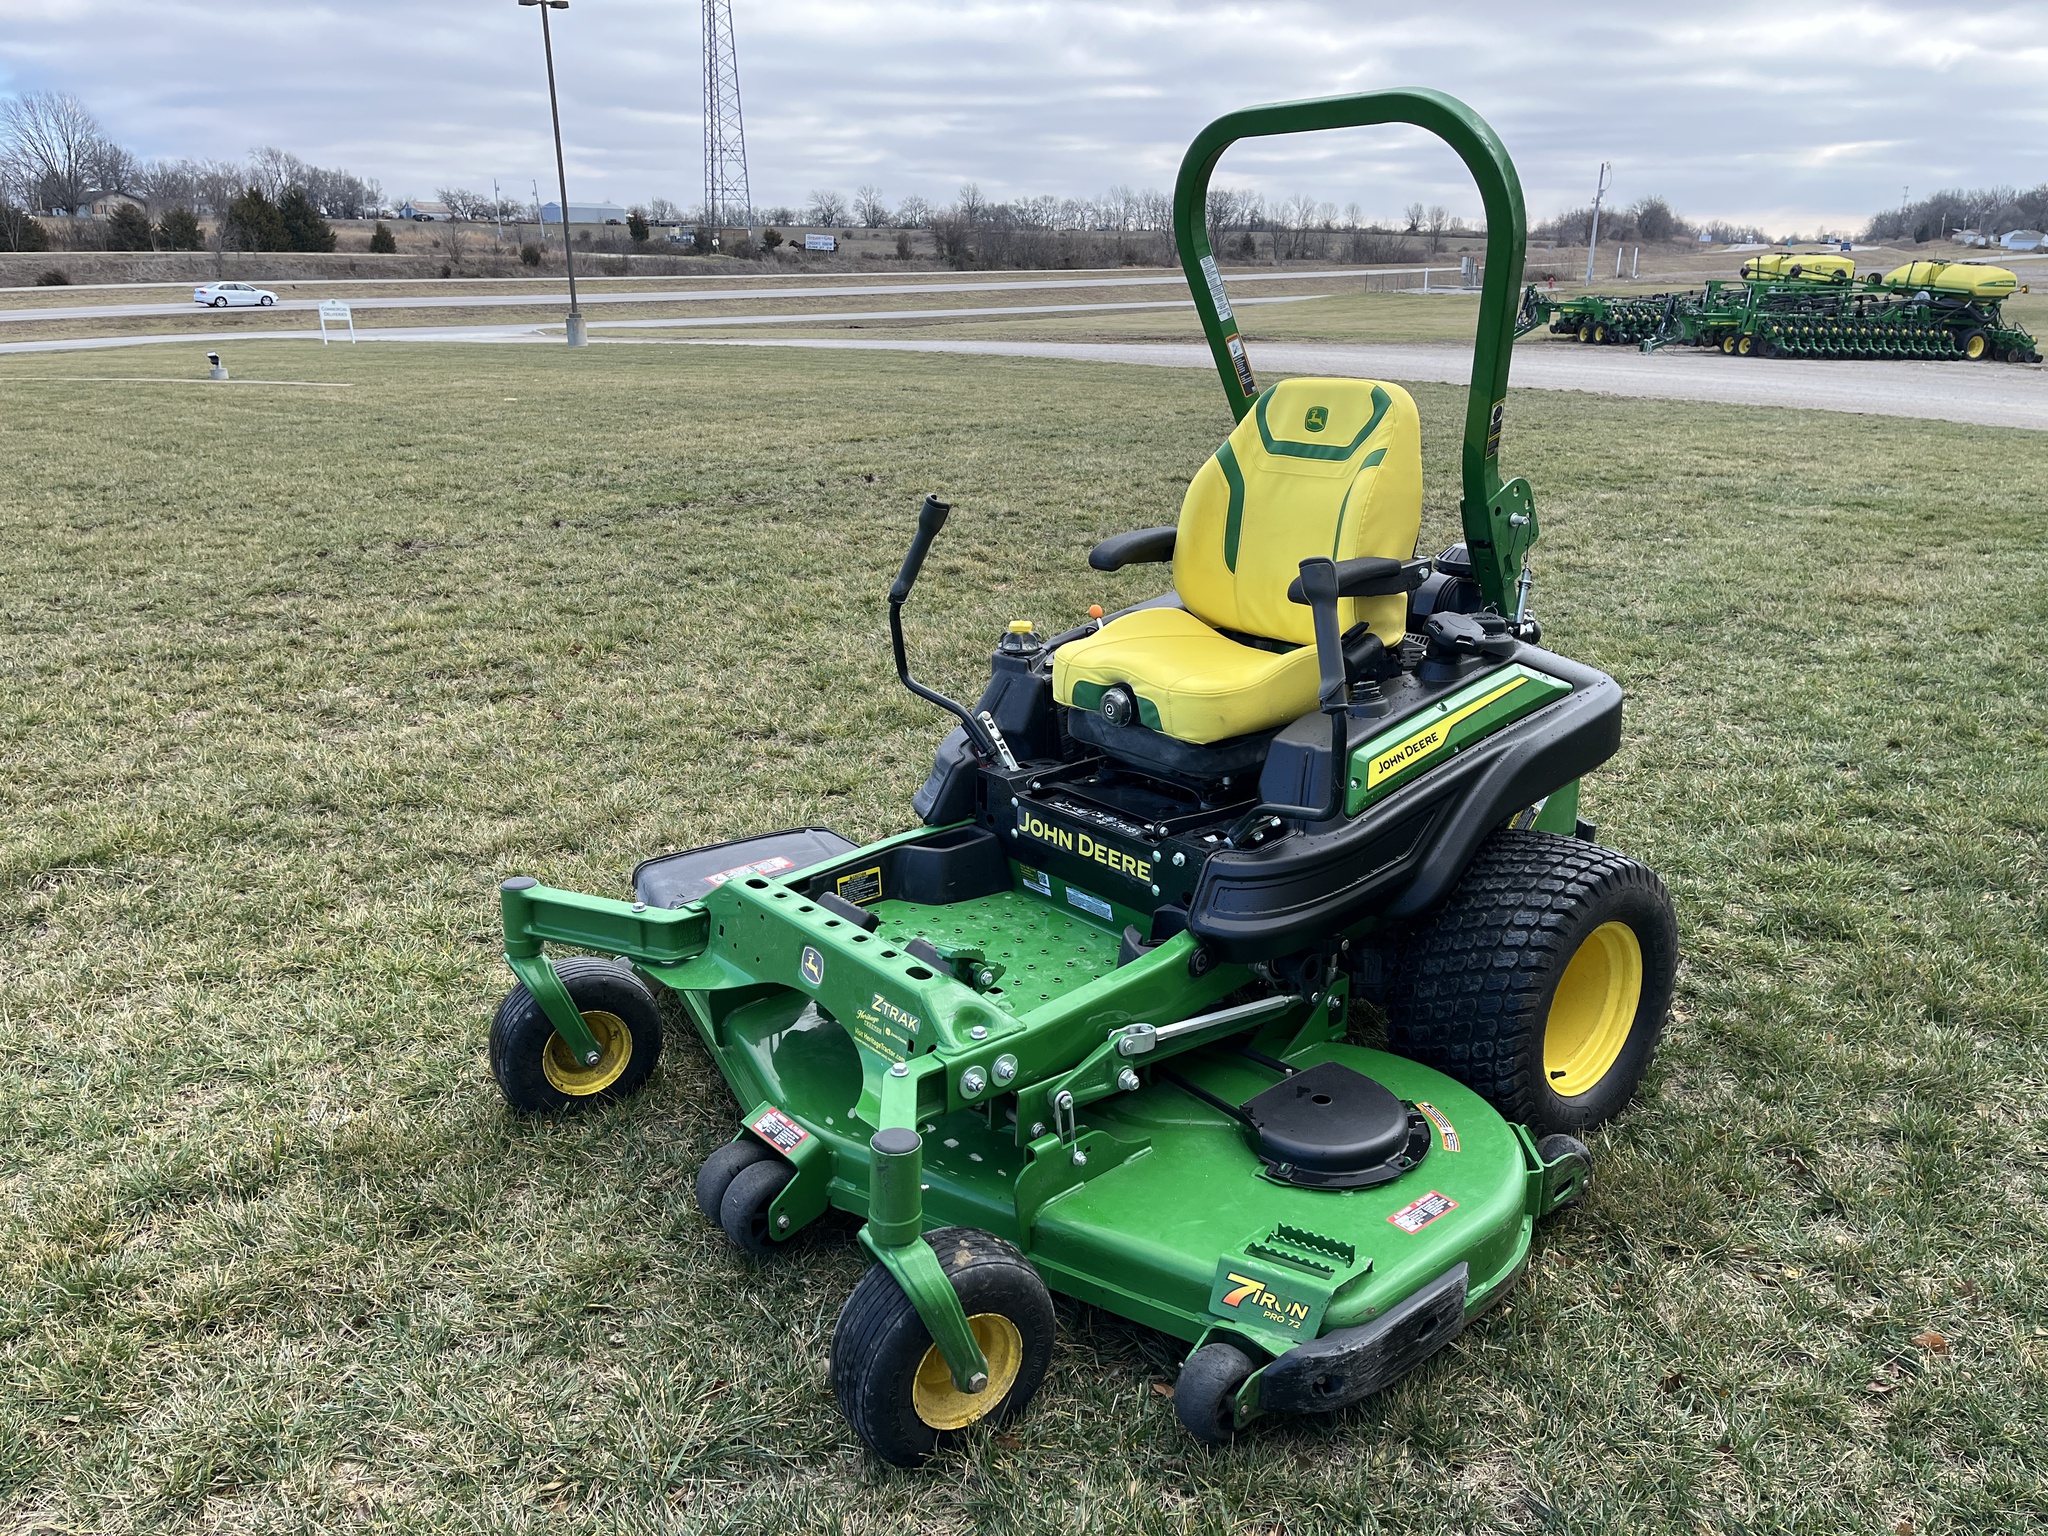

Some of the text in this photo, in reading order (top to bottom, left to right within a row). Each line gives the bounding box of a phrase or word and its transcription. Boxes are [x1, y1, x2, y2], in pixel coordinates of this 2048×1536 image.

[1378, 732, 1439, 774] JOHN DEERE
[1019, 812, 1073, 850] JOHN
[1078, 832, 1151, 882] DEERE
[856, 1009, 880, 1024] Heritage
[872, 993, 919, 1032] ZTRAK
[1263, 1310, 1301, 1329] PRO 72
